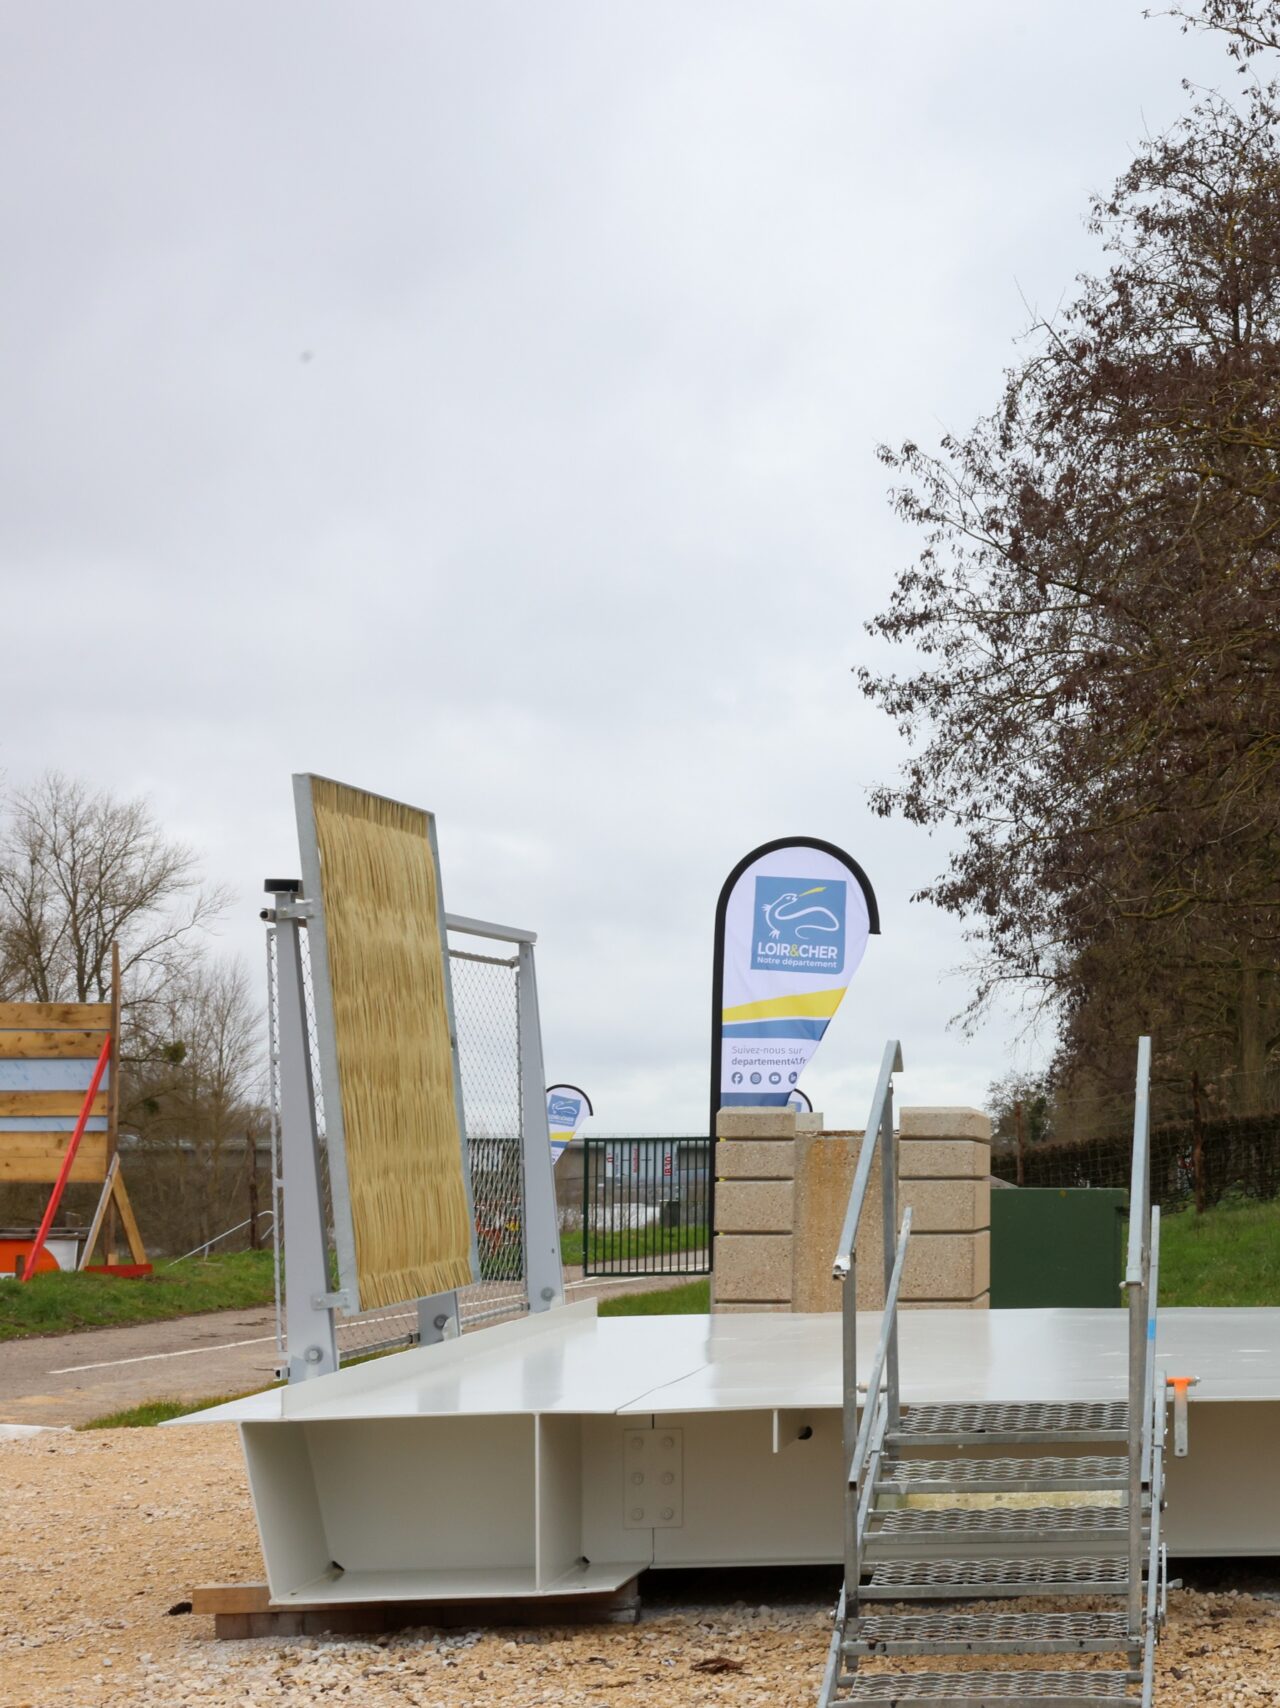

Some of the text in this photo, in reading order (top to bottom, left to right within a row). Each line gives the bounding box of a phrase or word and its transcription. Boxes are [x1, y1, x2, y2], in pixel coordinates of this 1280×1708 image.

[757, 941, 838, 959] LOIR&CHER
[756, 957, 837, 969] Notre département
[731, 1045, 803, 1055] Suivez-nous sur
